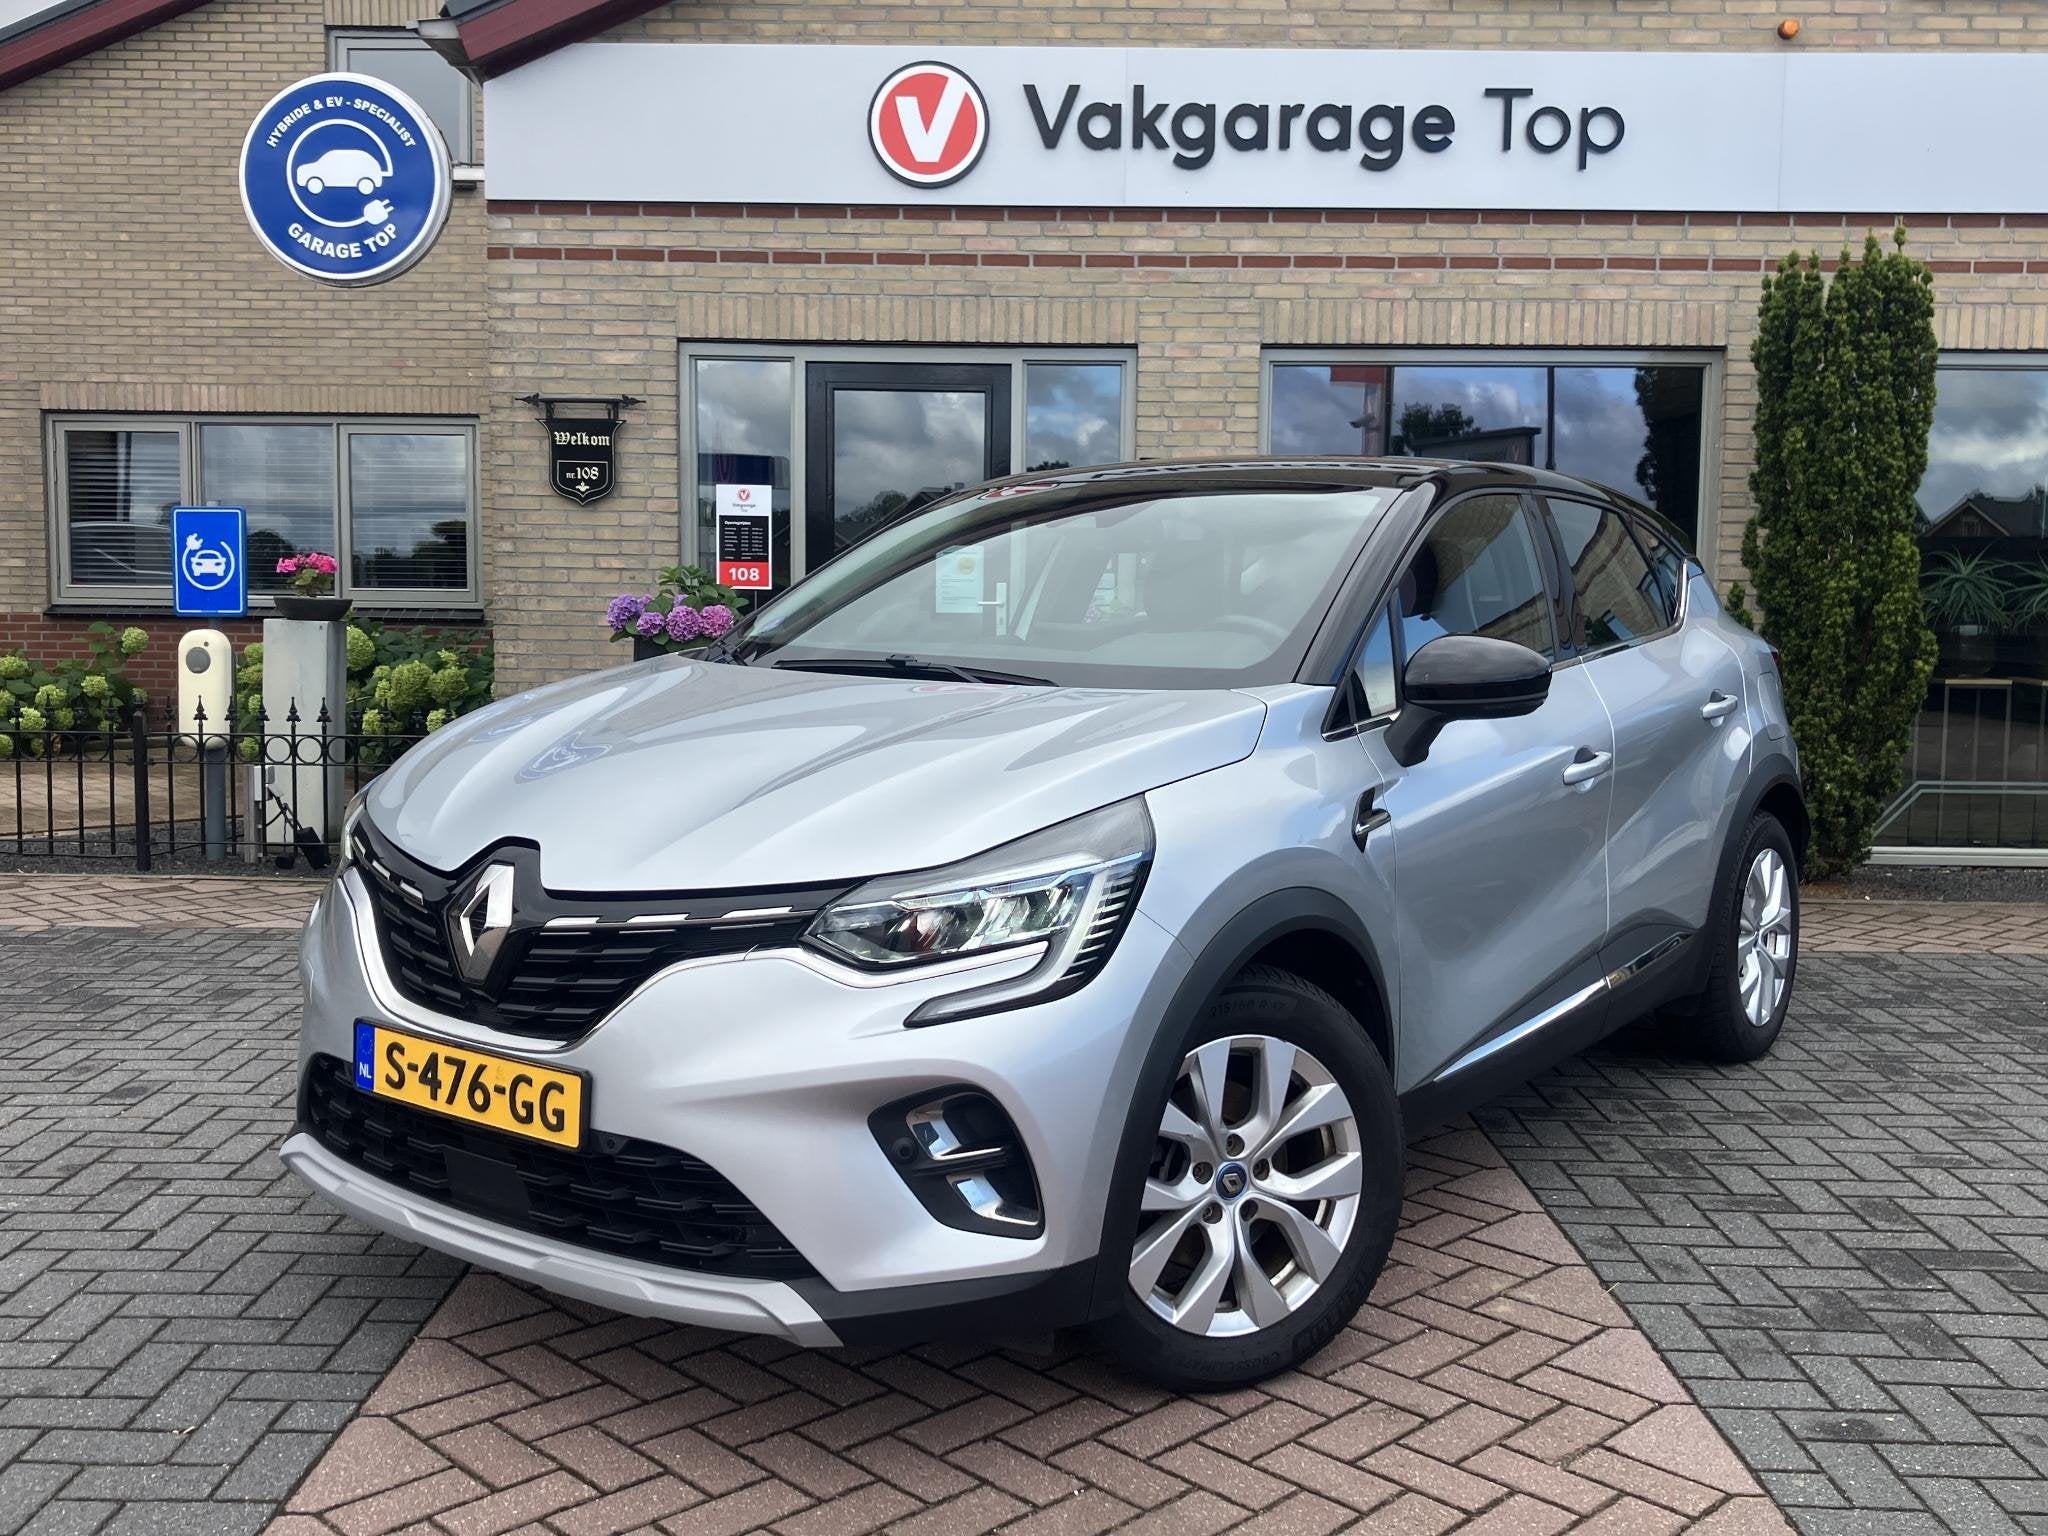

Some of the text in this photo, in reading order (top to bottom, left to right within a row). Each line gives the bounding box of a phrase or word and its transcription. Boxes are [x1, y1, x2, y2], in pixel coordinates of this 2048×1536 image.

[266, 104, 311, 148] HYBRIDE
[313, 99, 324, 110] &
[326, 96, 344, 109] EV
[353, 98, 417, 148] SPECIALIST
[1022, 83, 1626, 171] Vakgarage Top
[288, 223, 398, 259] GARAGE TOP
[554, 431, 610, 446] Welkom
[728, 567, 760, 582] 108
[359, 1062, 373, 1080] NL
[385, 1041, 565, 1133] S-476-GG
